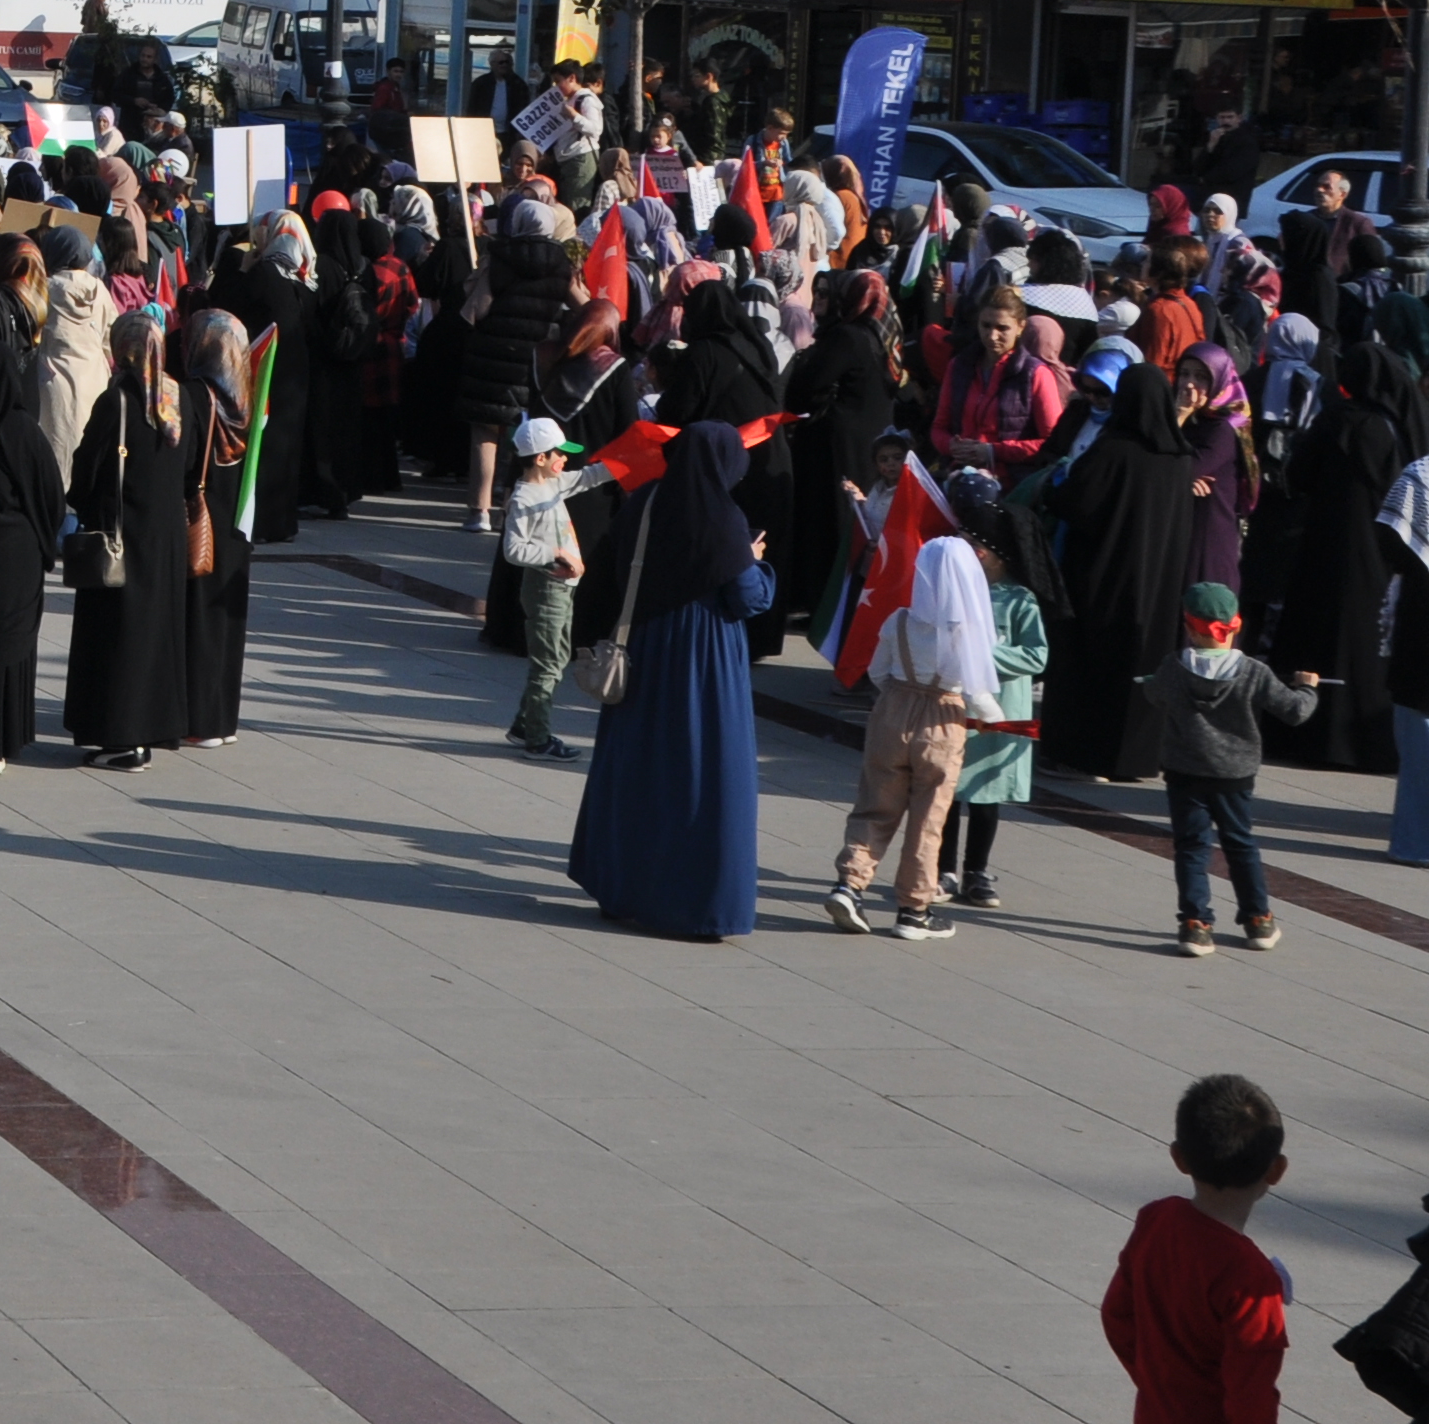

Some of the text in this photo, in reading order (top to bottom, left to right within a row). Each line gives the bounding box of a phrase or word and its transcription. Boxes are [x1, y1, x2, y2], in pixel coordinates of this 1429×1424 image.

[515, 88, 565, 132] Gazze'de
[881, 43, 914, 118] TEKEL
[869, 126, 897, 208] ARHAN
